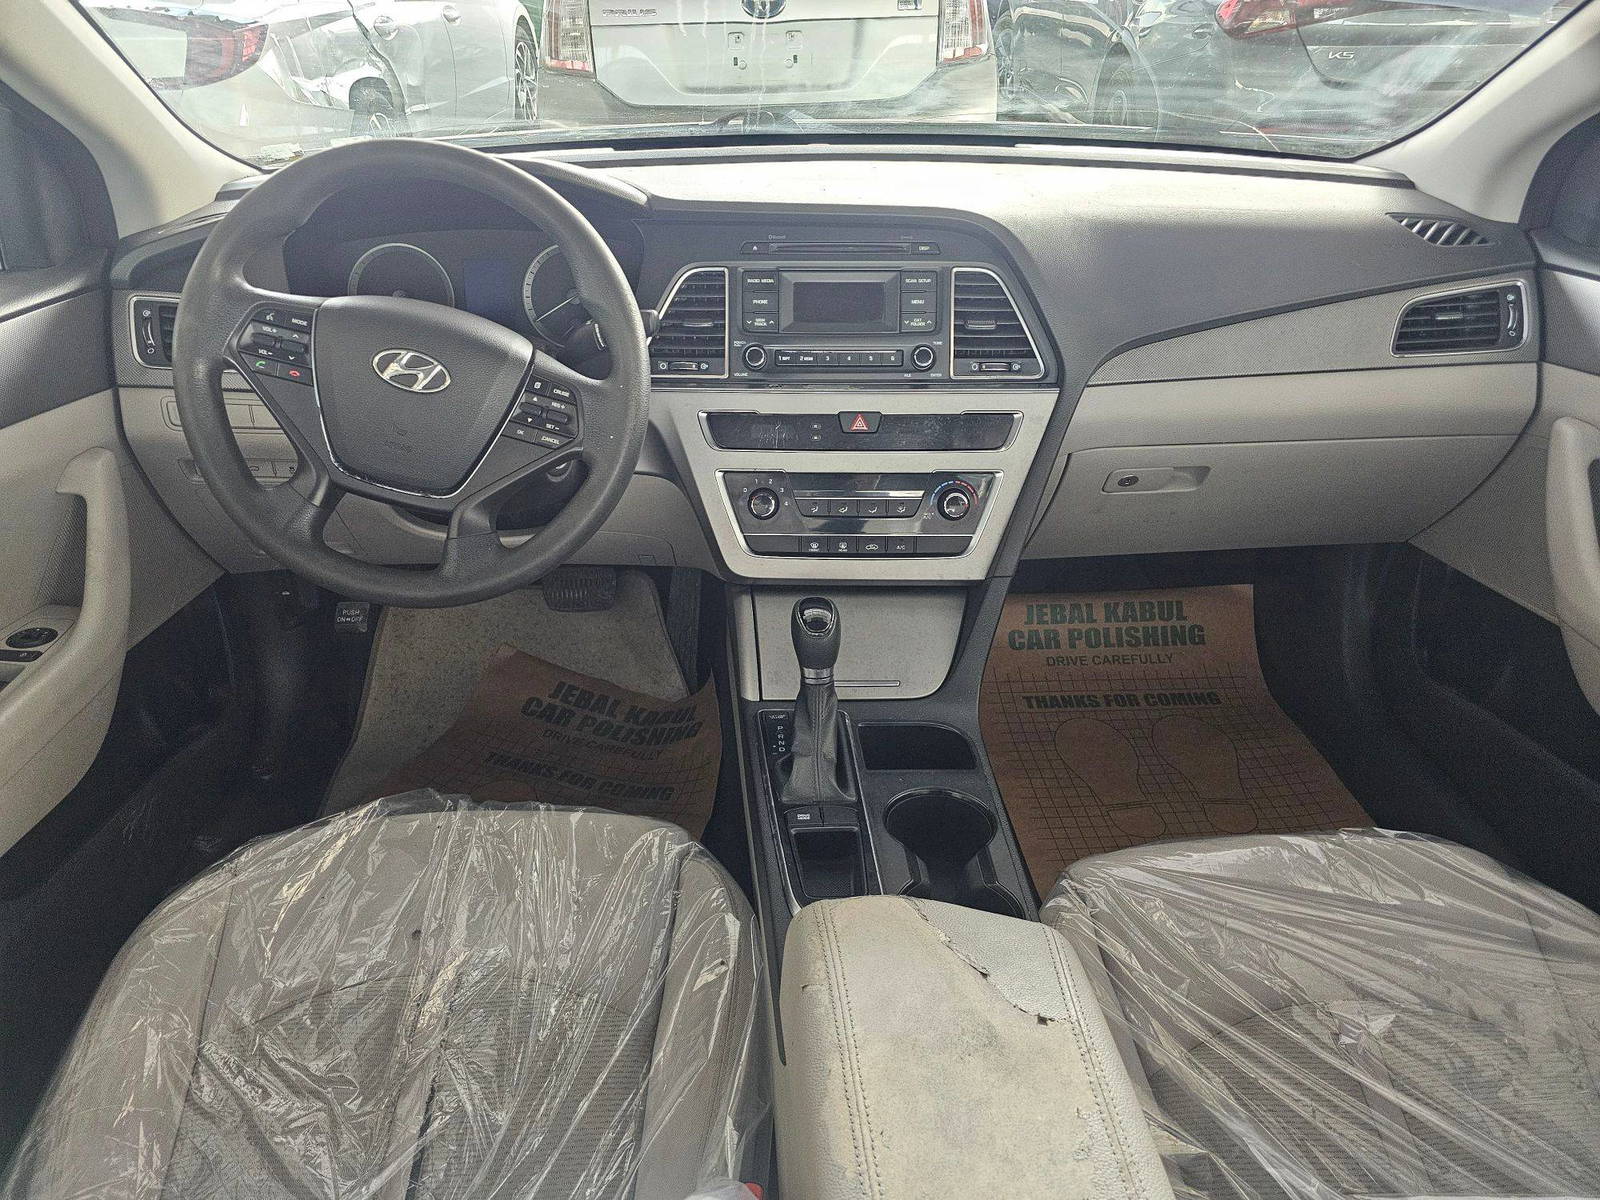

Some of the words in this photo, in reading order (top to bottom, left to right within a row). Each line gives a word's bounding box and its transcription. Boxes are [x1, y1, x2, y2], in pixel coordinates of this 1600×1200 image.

[1328, 51, 1355, 59] K5
[291, 318, 308, 326] MODE
[541, 436, 560, 445] CANCEL
[1024, 603, 1097, 625] JEBAL
[1103, 600, 1187, 623] KABUL
[1008, 629, 1061, 650] CAR
[1068, 625, 1207, 649] POLISHING
[1046, 655, 1089, 667] DRIVE
[1092, 653, 1173, 665] CAREFULLY
[548, 681, 621, 719] JEBAL
[1022, 694, 1098, 709] THANKS
[1103, 693, 1140, 707] FOR
[1144, 690, 1222, 706] COMING
[520, 697, 577, 727] CAR
[543, 729, 583, 747] DRIVE
[556, 770, 599, 790] FOR
